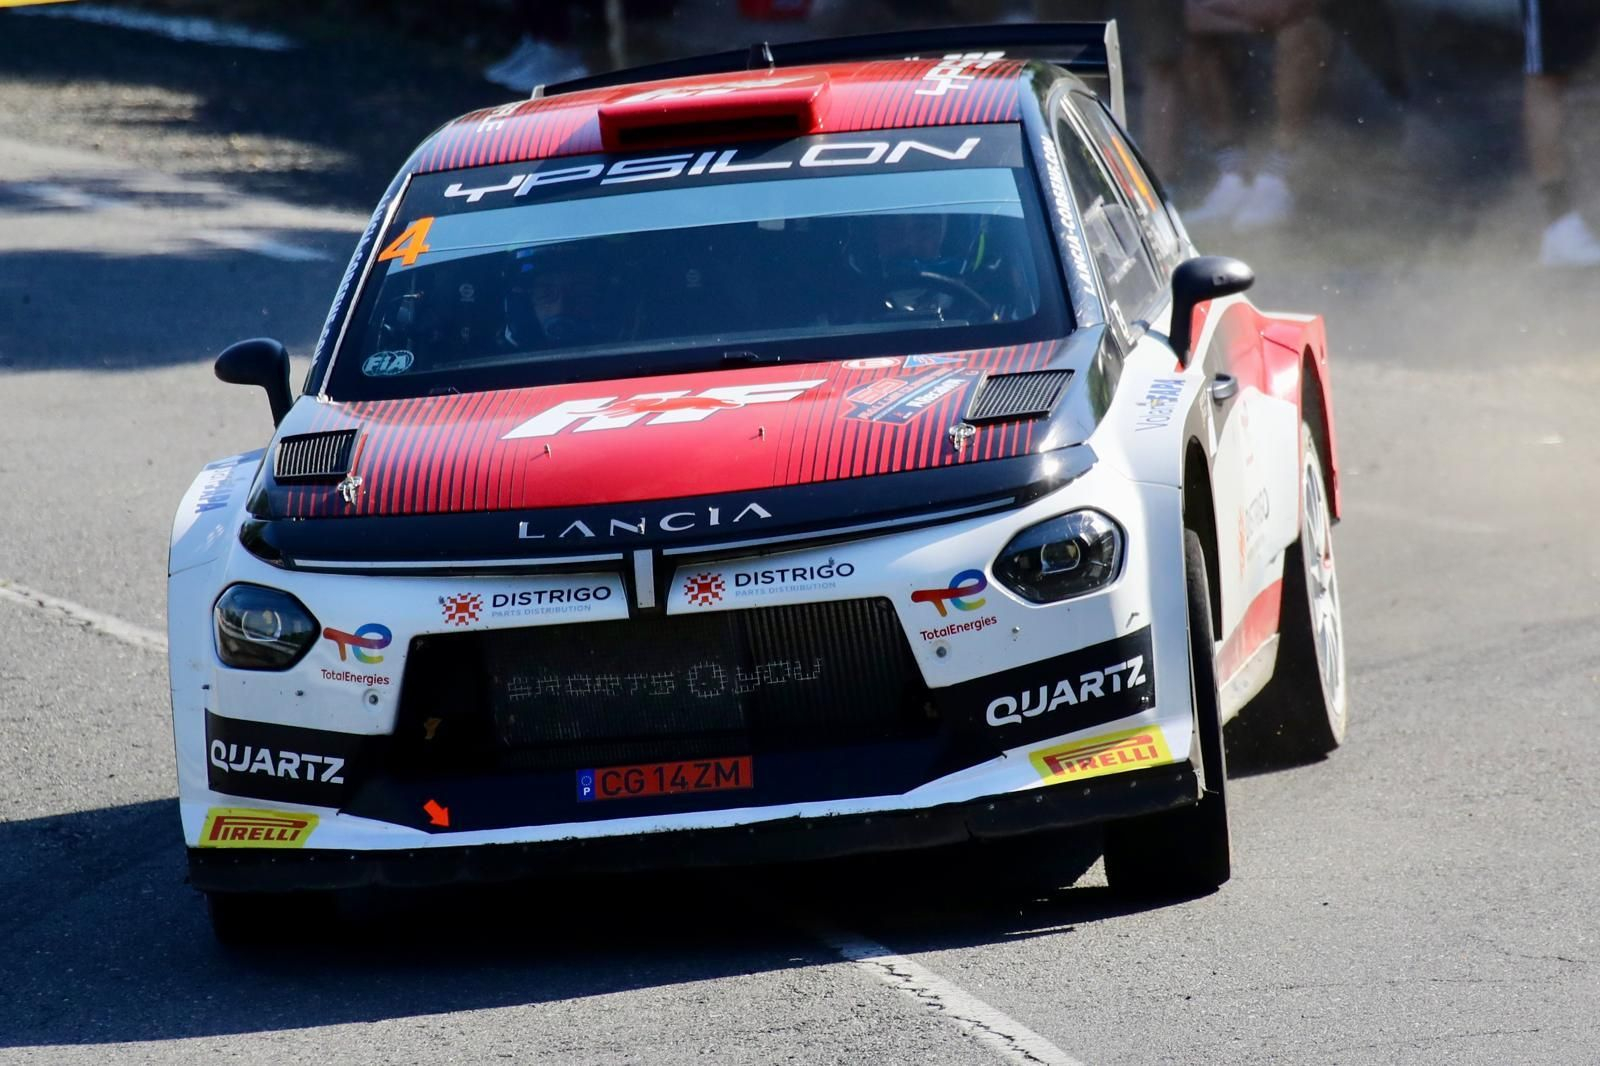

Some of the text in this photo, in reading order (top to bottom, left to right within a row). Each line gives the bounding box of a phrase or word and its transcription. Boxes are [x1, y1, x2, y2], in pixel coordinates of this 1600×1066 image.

[443, 137, 981, 203] YPSILON
[378, 217, 434, 266] 4
[367, 355, 409, 372] FIA
[517, 502, 772, 539] LANCIA
[733, 562, 856, 588] DISTRIGO
[492, 586, 612, 608] DISTRIGO
[734, 581, 837, 598] PARTS DISTRIBUTION
[491, 604, 592, 618] PARTS DISTRIBUTION
[919, 615, 998, 642] TotalEnergies
[321, 669, 390, 686] TotalEnergies
[985, 655, 1147, 728] QUARTZ
[210, 739, 346, 784] QUARTZ
[1043, 734, 1160, 776] PIRELLI
[583, 787, 591, 796] P
[209, 815, 308, 841] PIRELLI
